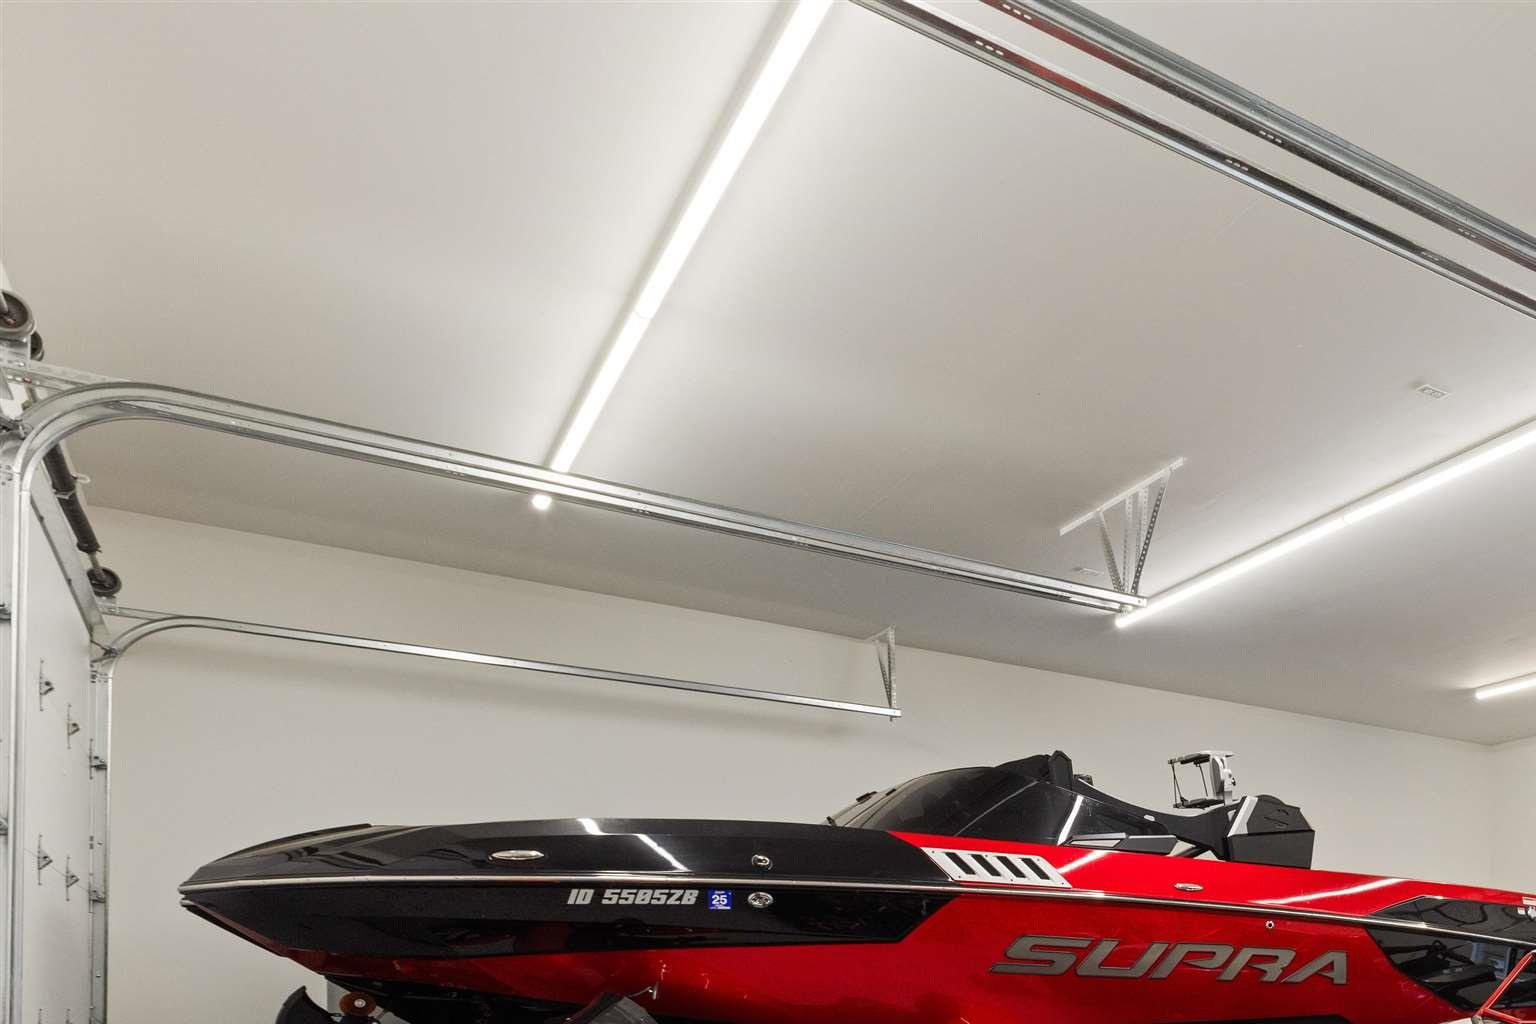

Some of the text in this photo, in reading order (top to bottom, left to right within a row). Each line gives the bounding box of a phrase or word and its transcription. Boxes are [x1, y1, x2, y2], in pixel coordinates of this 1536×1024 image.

[566, 888, 595, 905] ID
[711, 894, 728, 905] 25
[989, 933, 1349, 985] SUPRA
